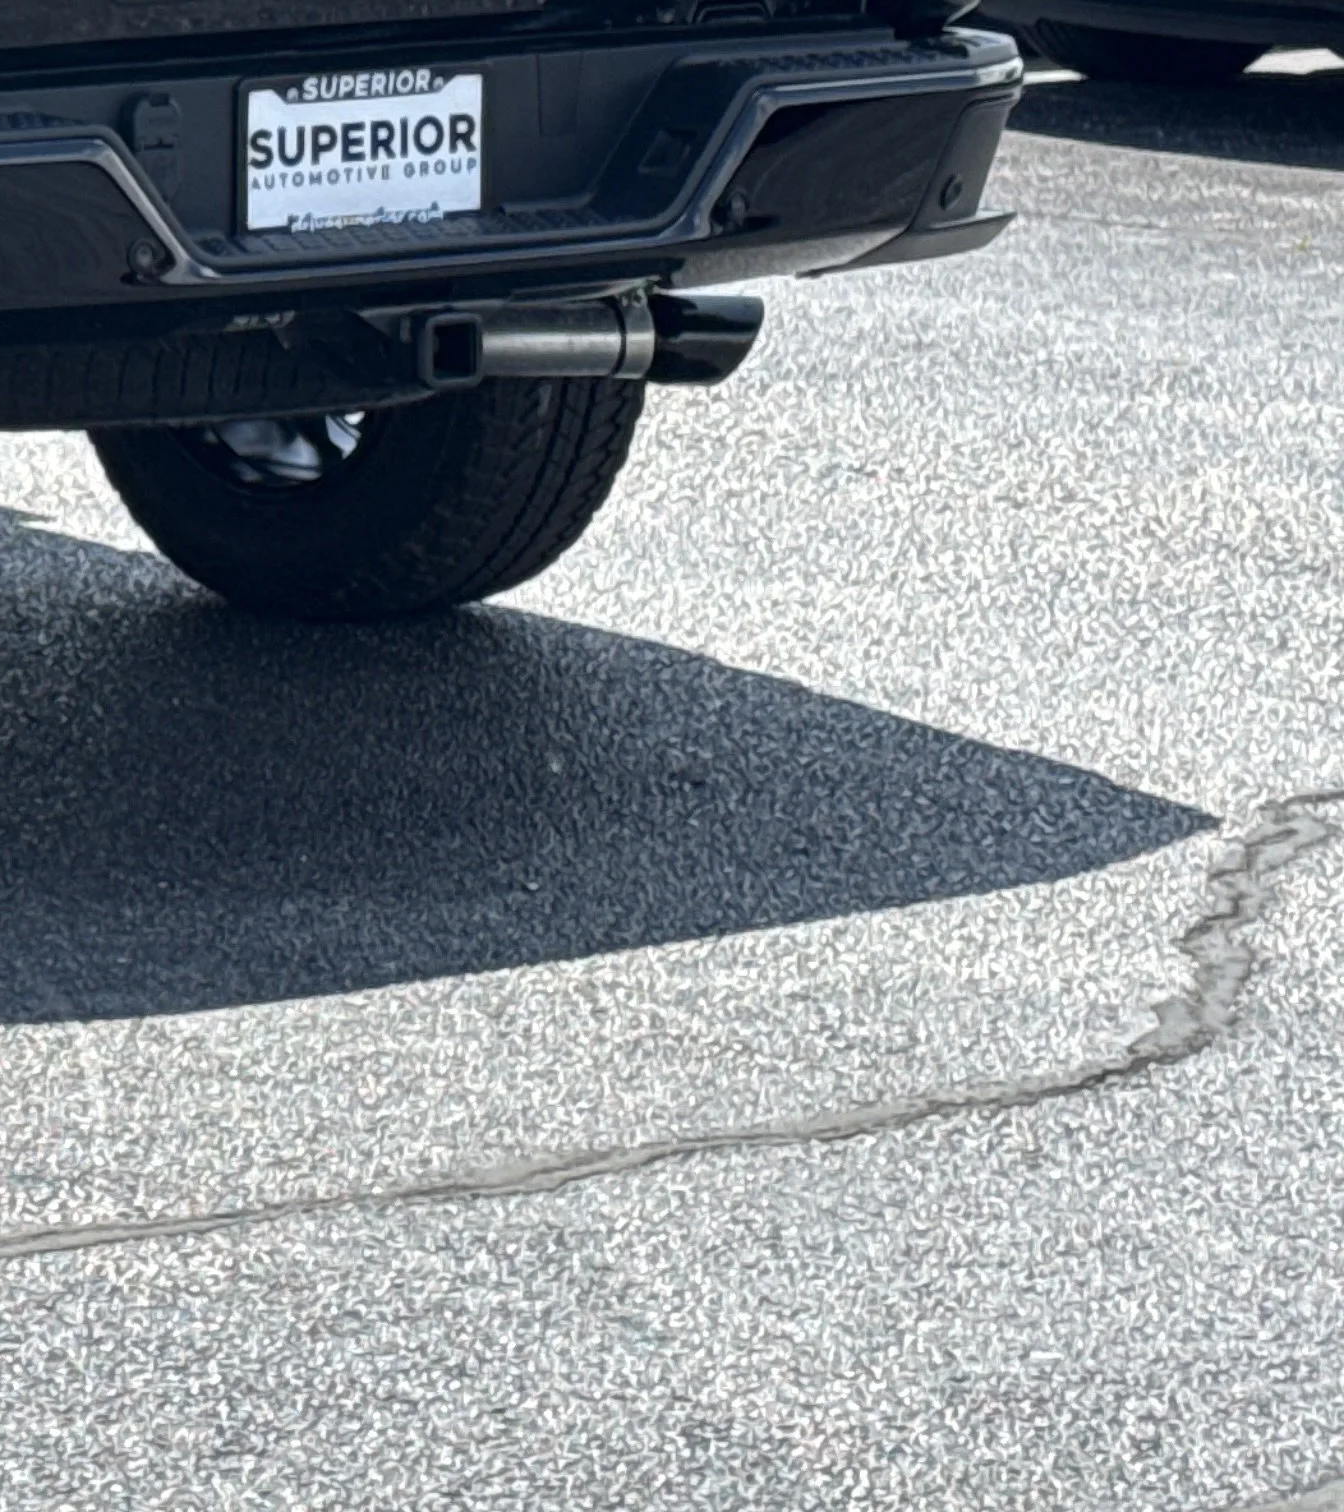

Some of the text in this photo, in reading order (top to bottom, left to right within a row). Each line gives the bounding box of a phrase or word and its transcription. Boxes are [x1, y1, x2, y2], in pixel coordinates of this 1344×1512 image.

[302, 68, 432, 101] SUPERIOR
[249, 113, 477, 170] SUPERIOR
[251, 157, 478, 190] AUTOMOTIVE GROUP
